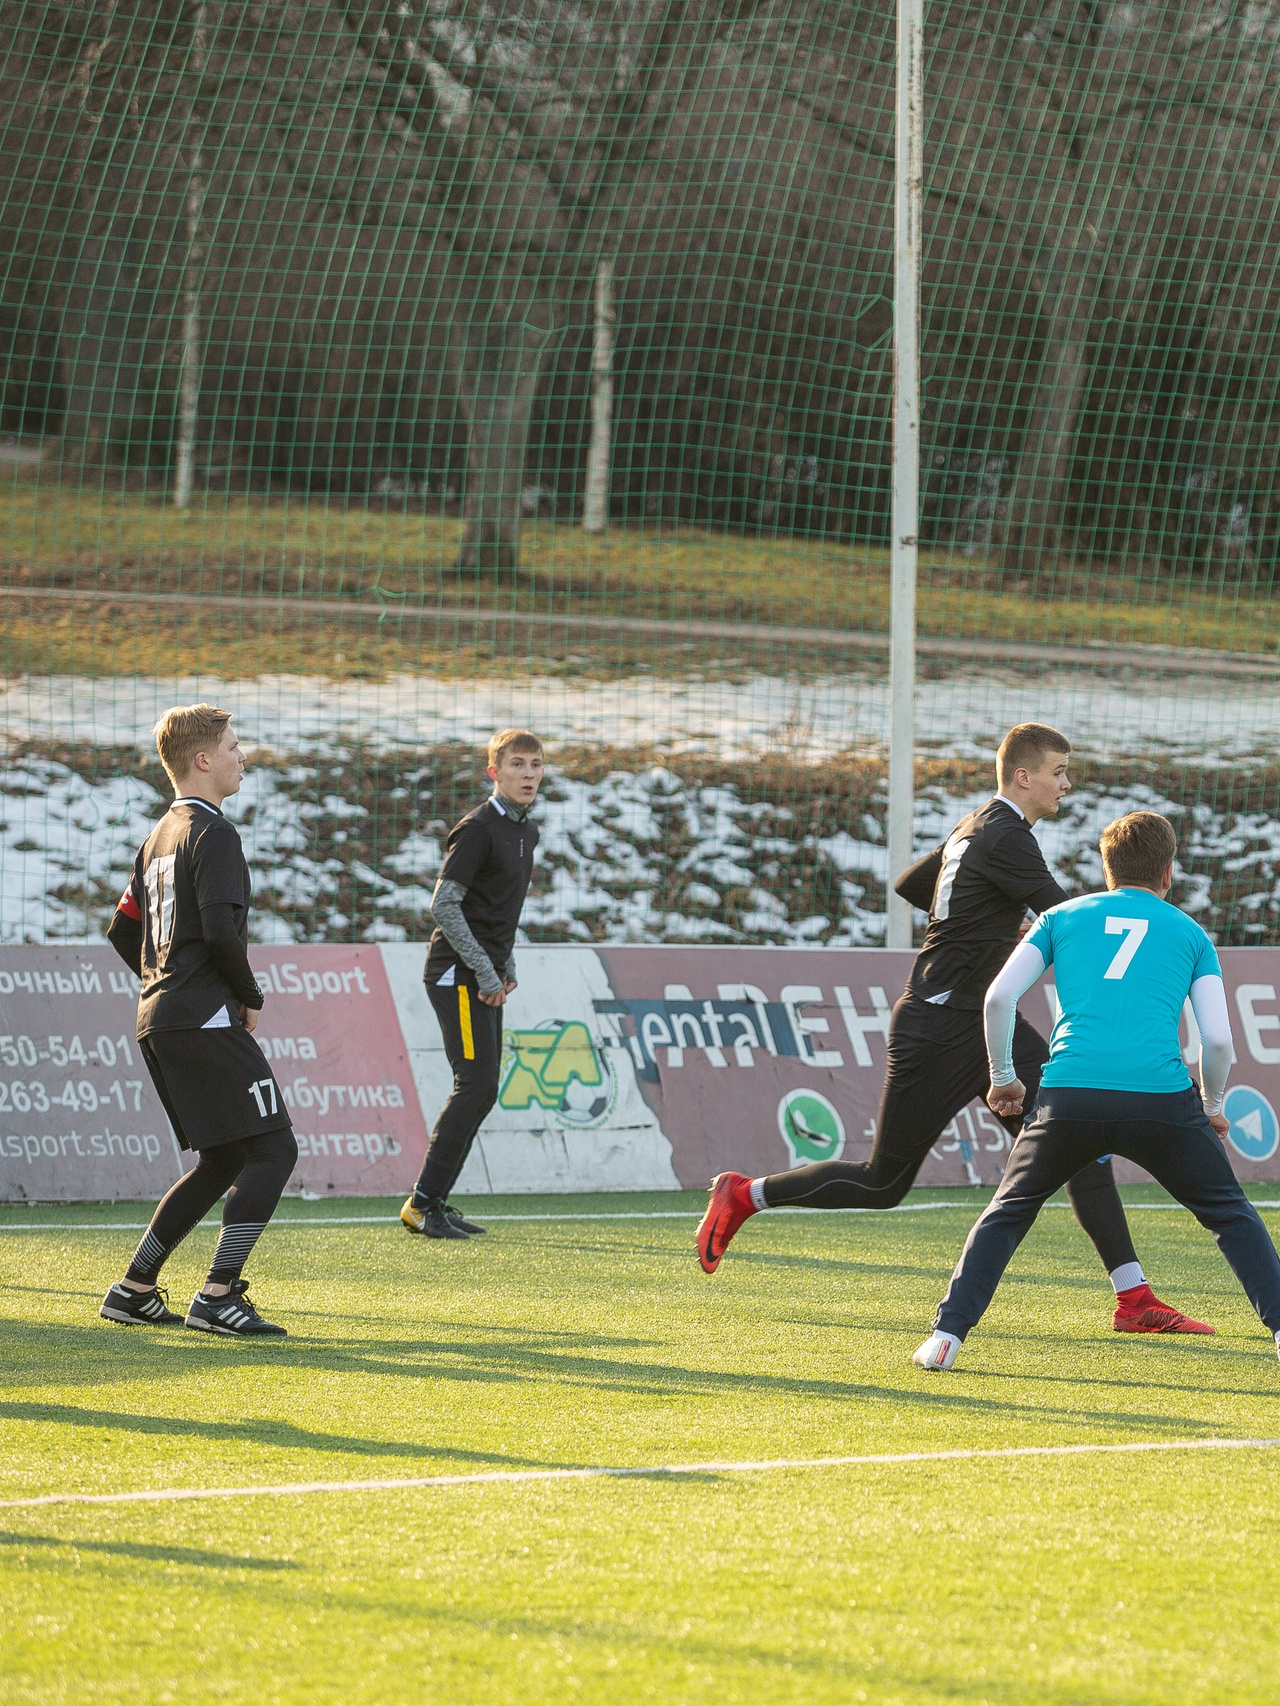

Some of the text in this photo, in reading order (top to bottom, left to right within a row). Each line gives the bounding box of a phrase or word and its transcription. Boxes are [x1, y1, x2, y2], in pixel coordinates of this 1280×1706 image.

[1103, 915, 1149, 980] 7
[0, 962, 103, 994] очный
[253, 963, 371, 1001] alSport
[0, 1080, 143, 1113] 263-49-17
[248, 1078, 278, 1118] 17
